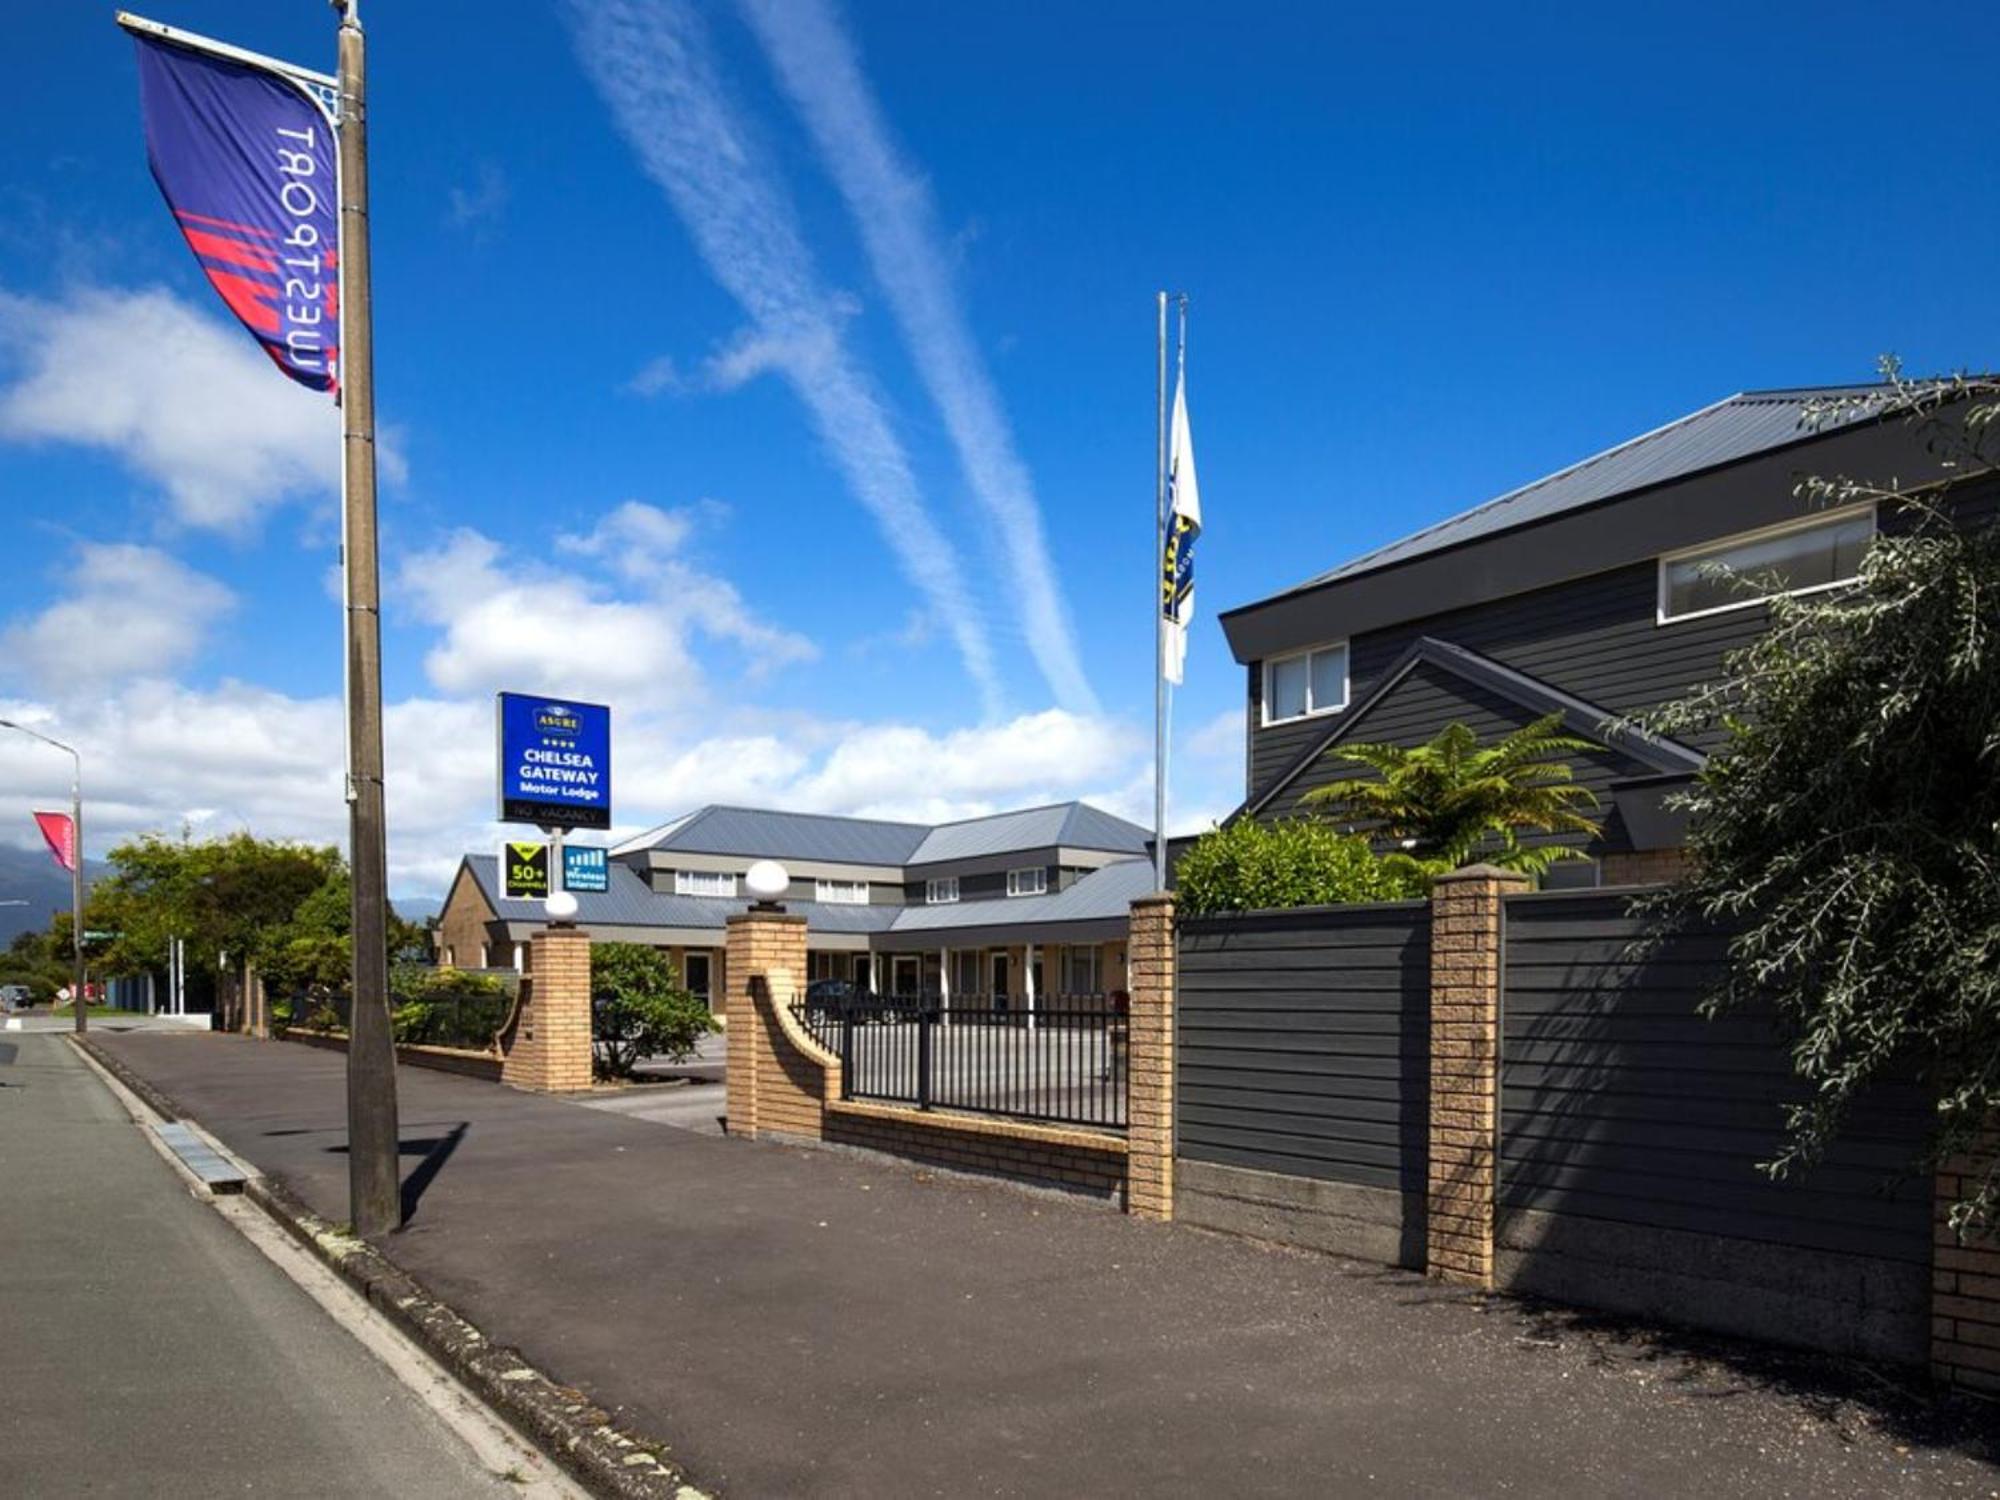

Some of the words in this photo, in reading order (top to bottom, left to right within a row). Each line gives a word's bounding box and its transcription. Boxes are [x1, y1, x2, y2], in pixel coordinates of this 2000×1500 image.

[523, 748, 593, 768] CHELSEA
[519, 765, 599, 785] GATEWAY
[520, 782, 559, 795] Motor
[562, 786, 600, 800] Lodge
[512, 864, 545, 880] 50+
